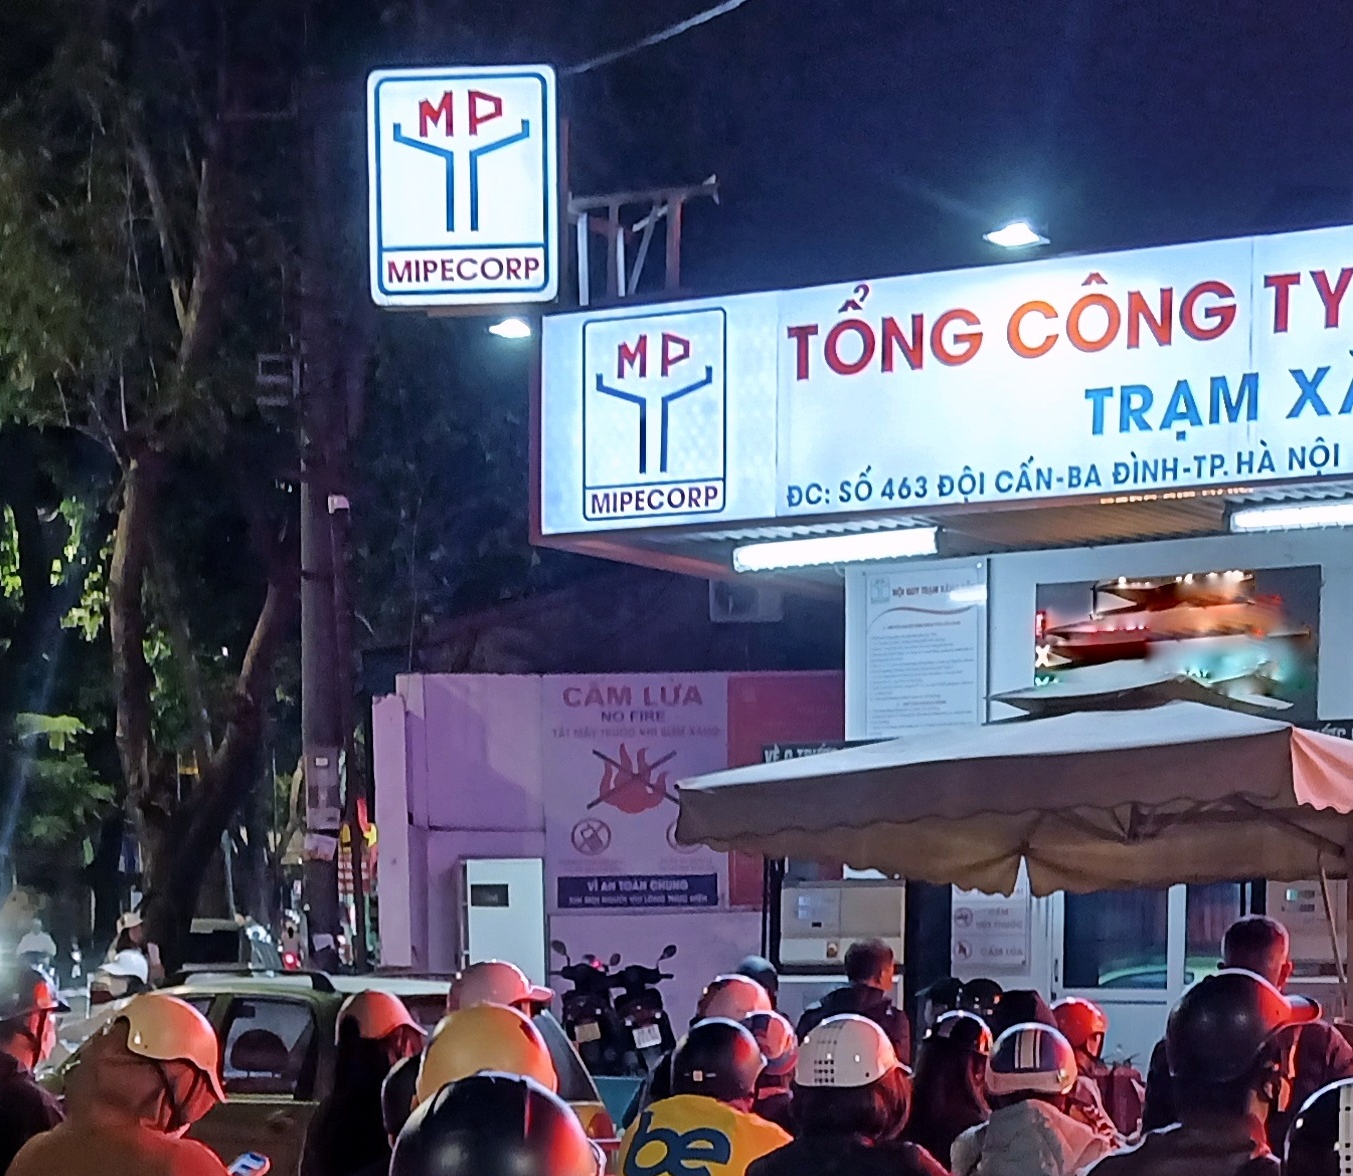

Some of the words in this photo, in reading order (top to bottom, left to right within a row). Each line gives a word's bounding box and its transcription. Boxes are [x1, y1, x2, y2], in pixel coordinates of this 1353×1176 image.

[388, 257, 539, 283] MIPECORP
[788, 284, 983, 380] TỔNG
[1008, 274, 1236, 358] CÔNG
[1086, 373, 1258, 441] TRẠM
[787, 482, 831, 508] ĐC:
[838, 466, 873, 503] SỐ
[881, 476, 928, 501] 463
[938, 466, 986, 503] ĐỘI
[1236, 441, 1270, 475] HÀ
[1288, 442, 1340, 476] NỘI
[591, 486, 718, 515] MIPECORP
[602, 711, 624, 723] NO
[631, 710, 666, 723] FIRE
